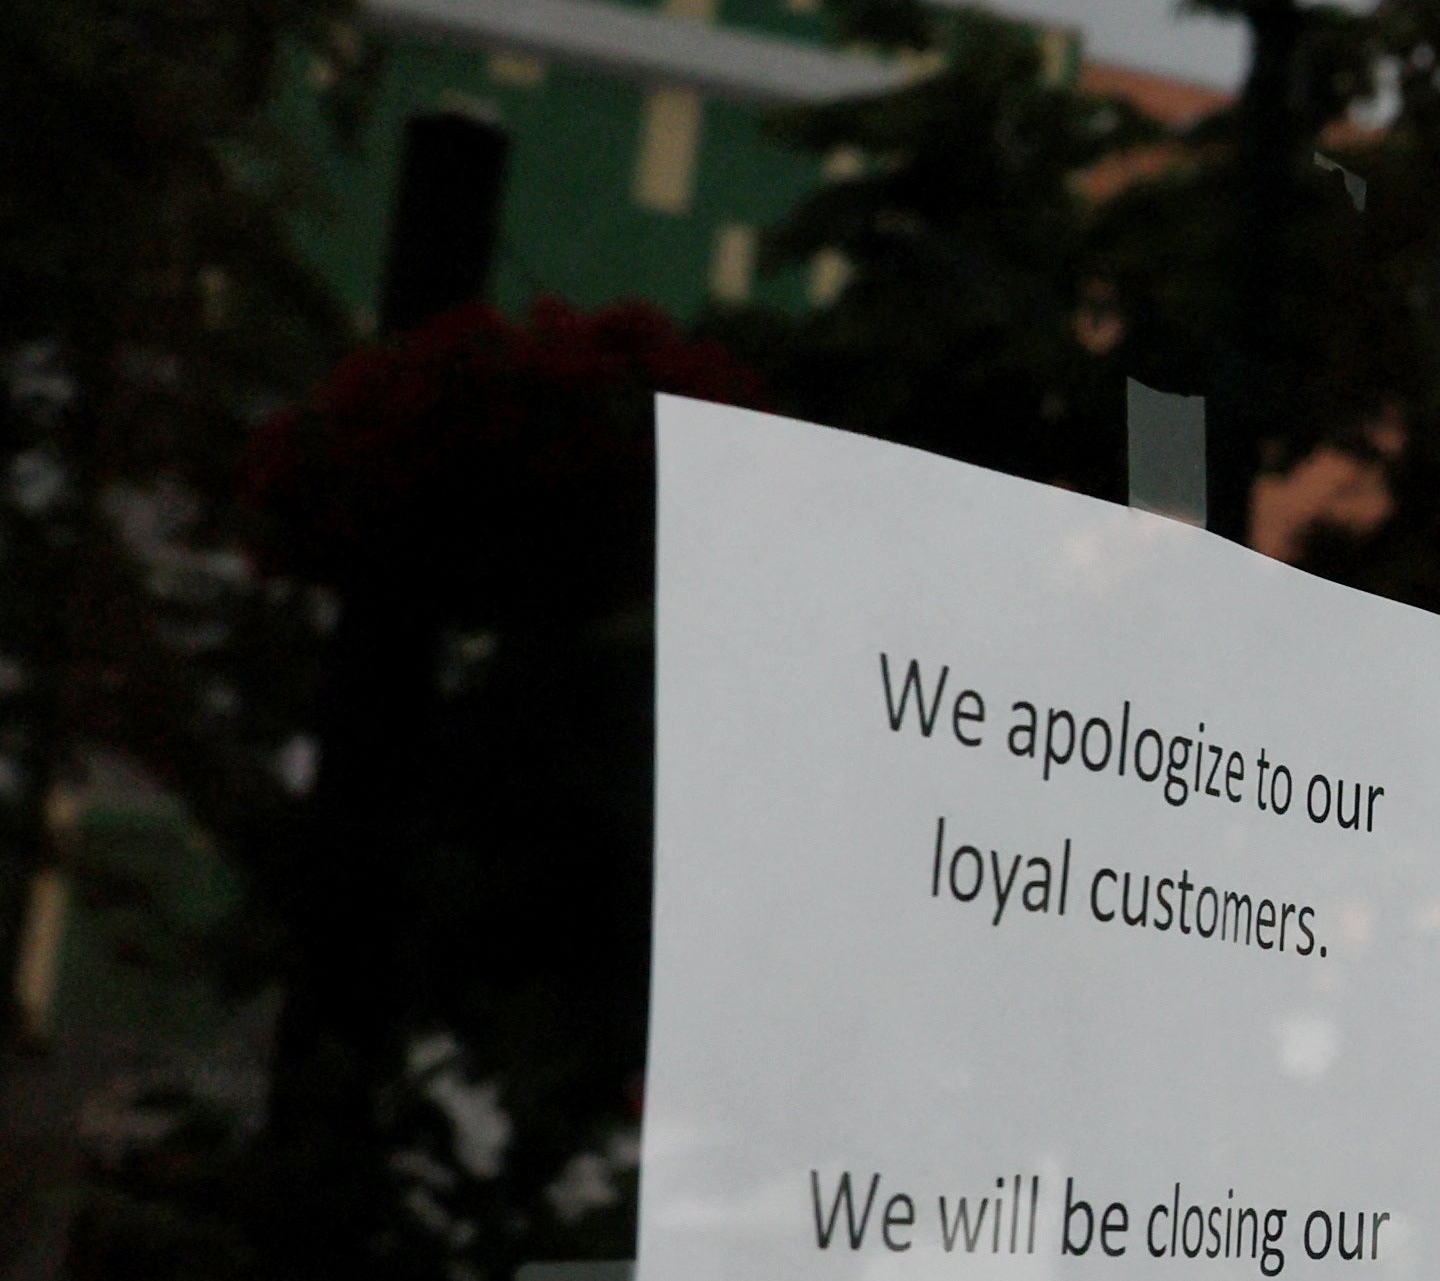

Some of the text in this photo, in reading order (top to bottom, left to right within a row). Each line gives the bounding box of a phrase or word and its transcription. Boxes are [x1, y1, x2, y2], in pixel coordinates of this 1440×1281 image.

[877, 650, 1387, 835] We apologize to our
[929, 814, 1329, 960] loyal customers.
[808, 1168, 1392, 1279] We will be closing our
